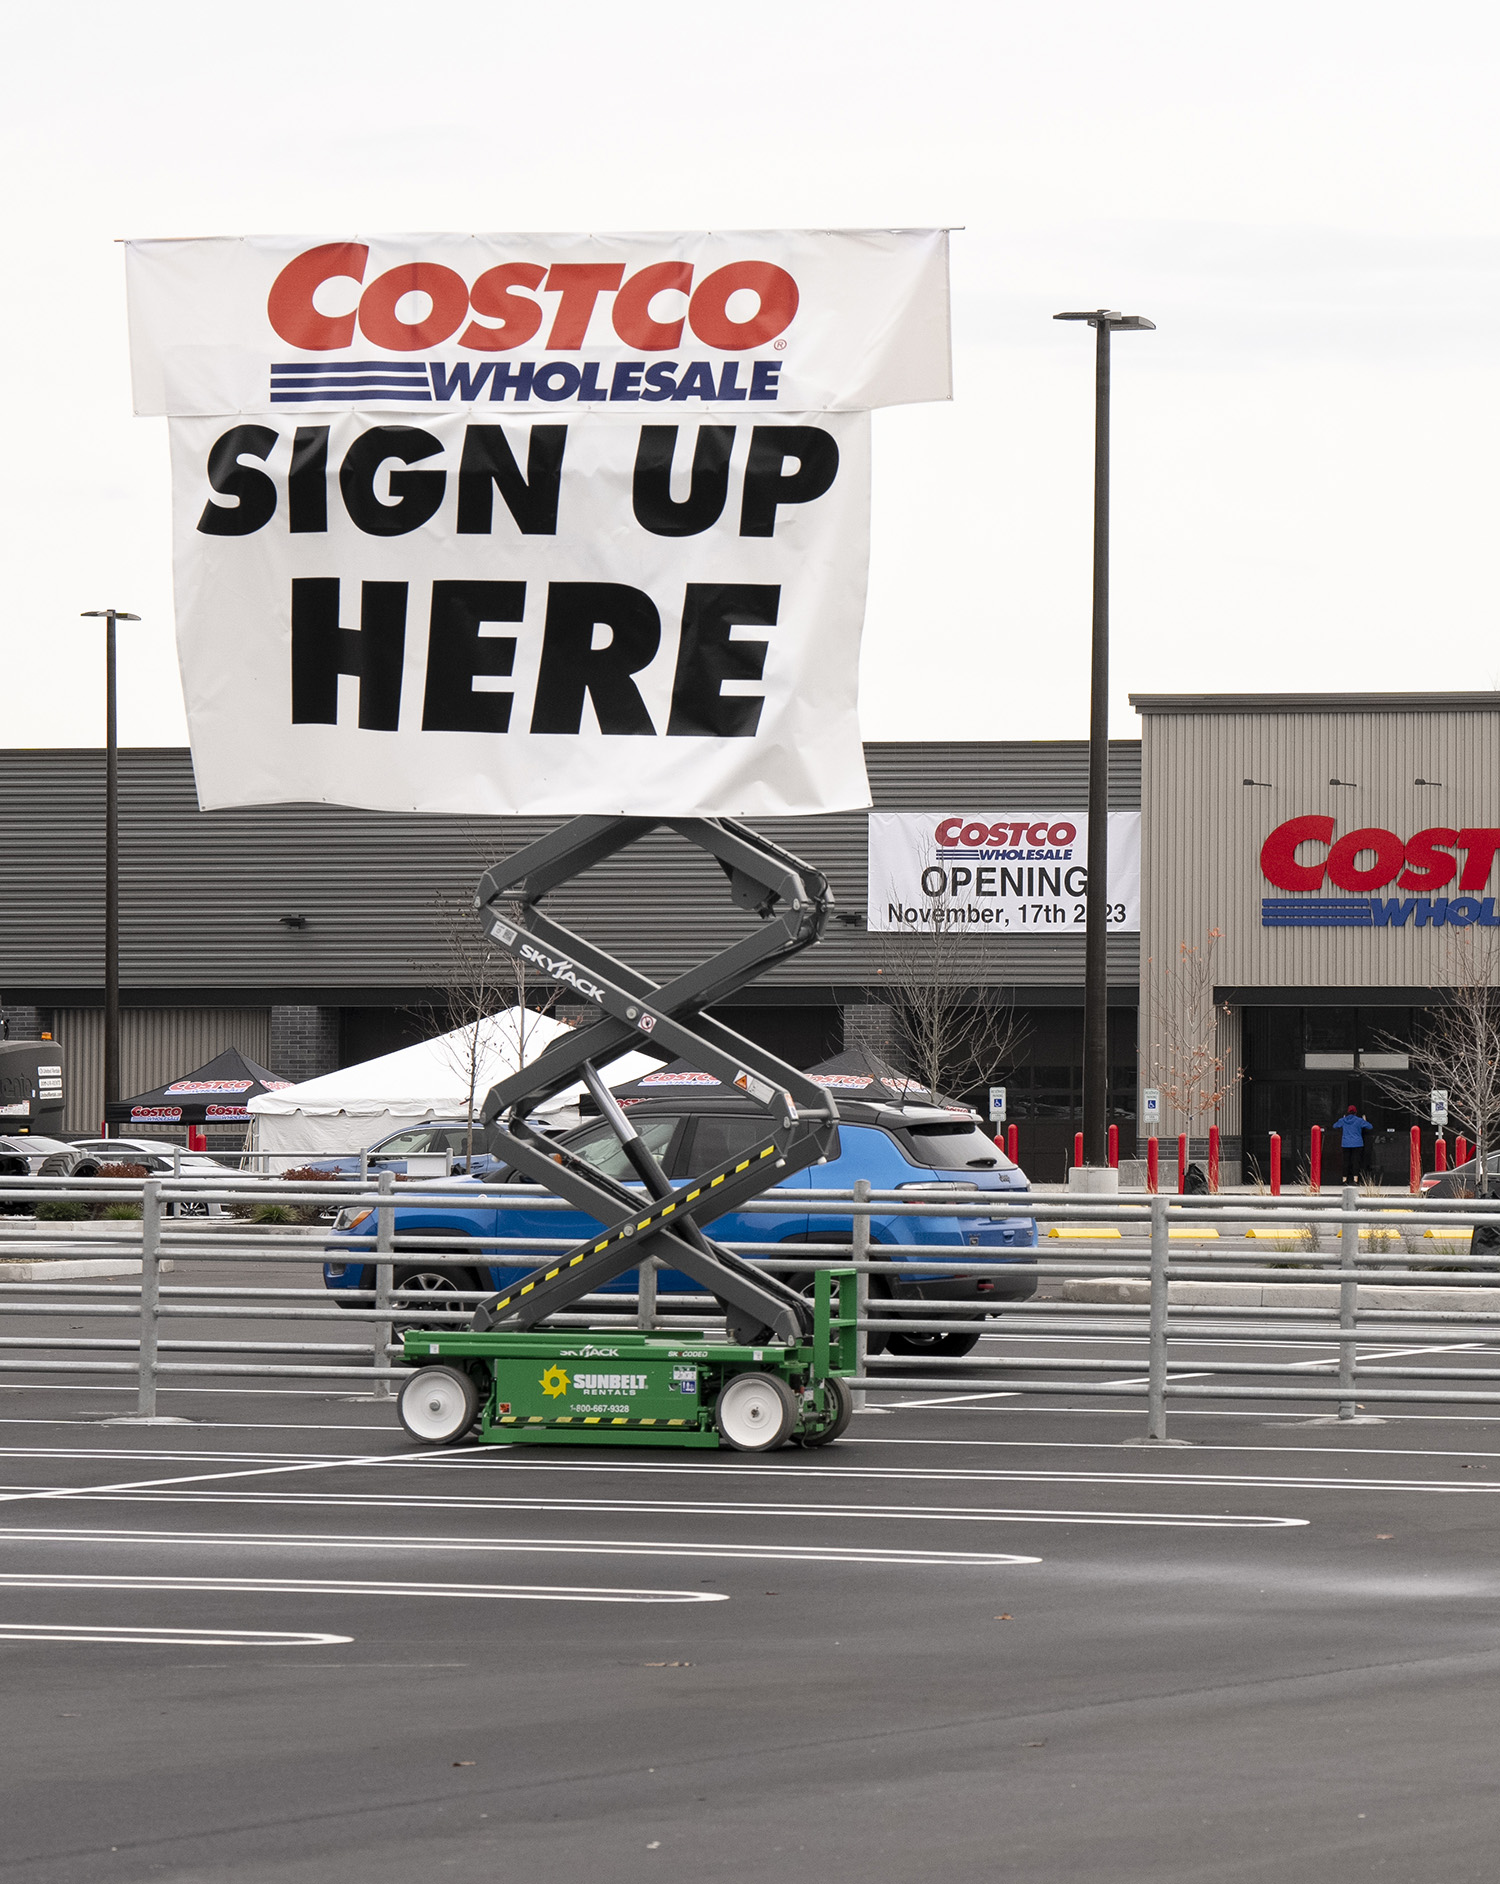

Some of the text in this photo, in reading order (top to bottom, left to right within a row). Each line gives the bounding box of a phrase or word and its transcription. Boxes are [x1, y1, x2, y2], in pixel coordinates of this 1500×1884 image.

[267, 243, 799, 351] COSTCO
[431, 361, 783, 402] WHOLESALE
[197, 424, 840, 538] SIGN UP
[291, 577, 781, 738] HERE
[935, 818, 1077, 847] COSTCO
[980, 849, 1073, 861] WHOLESALE
[921, 866, 1088, 897] OPENING
[888, 904, 1127, 927] November, 17th 223
[519, 943, 606, 1003] SKYJACK
[169, 1080, 254, 1091] COSTCO
[131, 1106, 182, 1117] COSTCO
[206, 1105, 249, 1116] COSTC
[573, 1374, 647, 1390] SUNBELT
[570, 1404, 630, 1413] 1-800-667-9328
